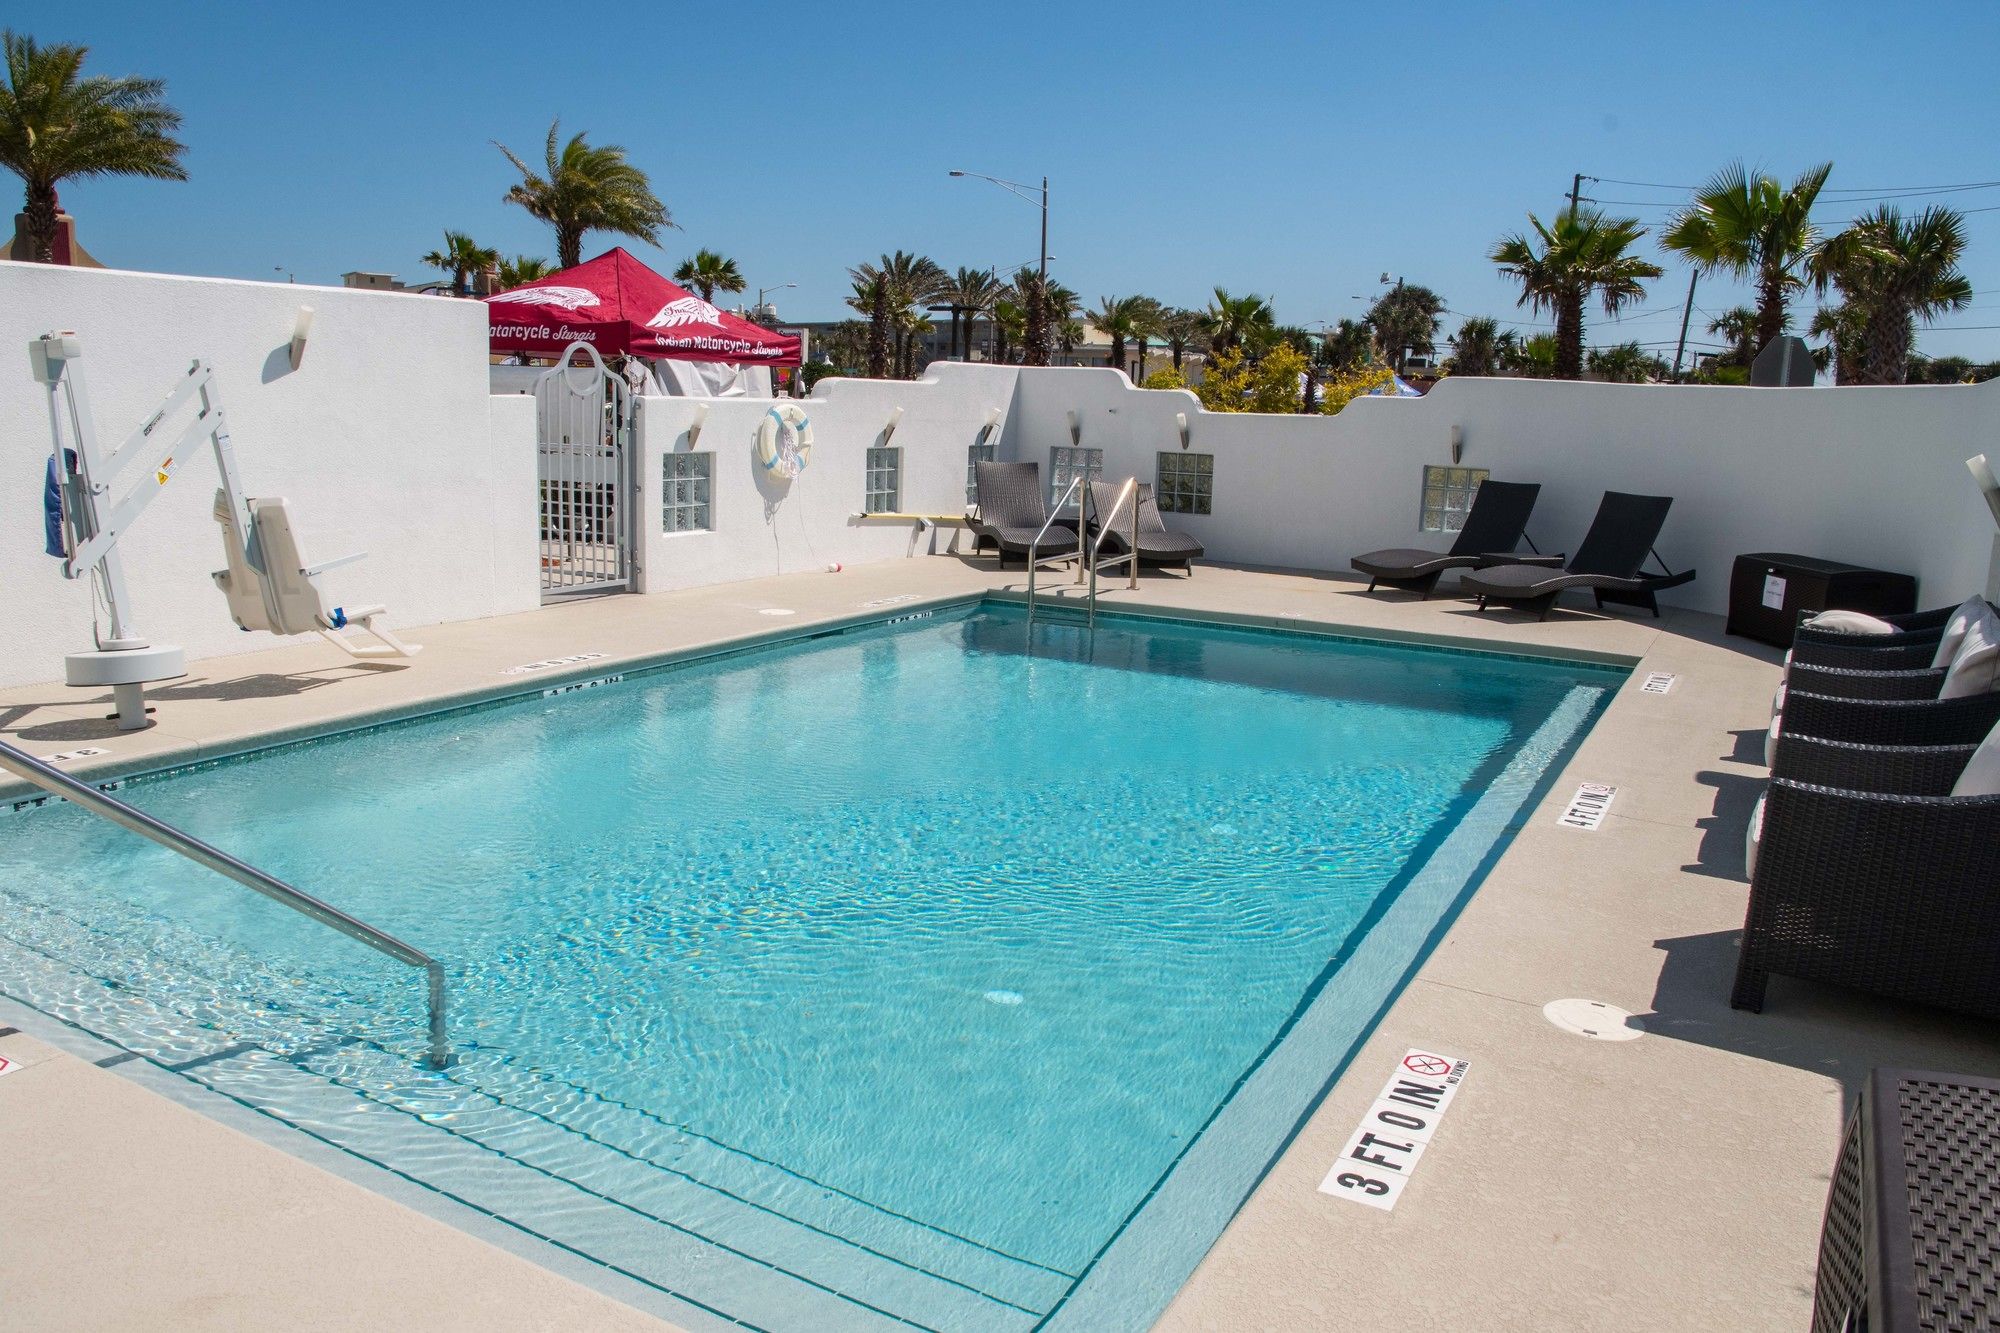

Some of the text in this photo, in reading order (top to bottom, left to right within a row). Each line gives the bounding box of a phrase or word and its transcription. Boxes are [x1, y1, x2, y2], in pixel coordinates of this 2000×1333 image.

[489, 324, 596, 341] otorcycle Sturgis
[655, 333, 692, 347] Indian
[693, 335, 751, 354] Motorcycle
[1563, 819, 1593, 827] 4
[1445, 1060, 1469, 1085] NO DIVING
[1388, 1079, 1447, 1110] IN.
[1350, 1132, 1414, 1171] FT.
[1336, 1172, 1390, 1196] 3
